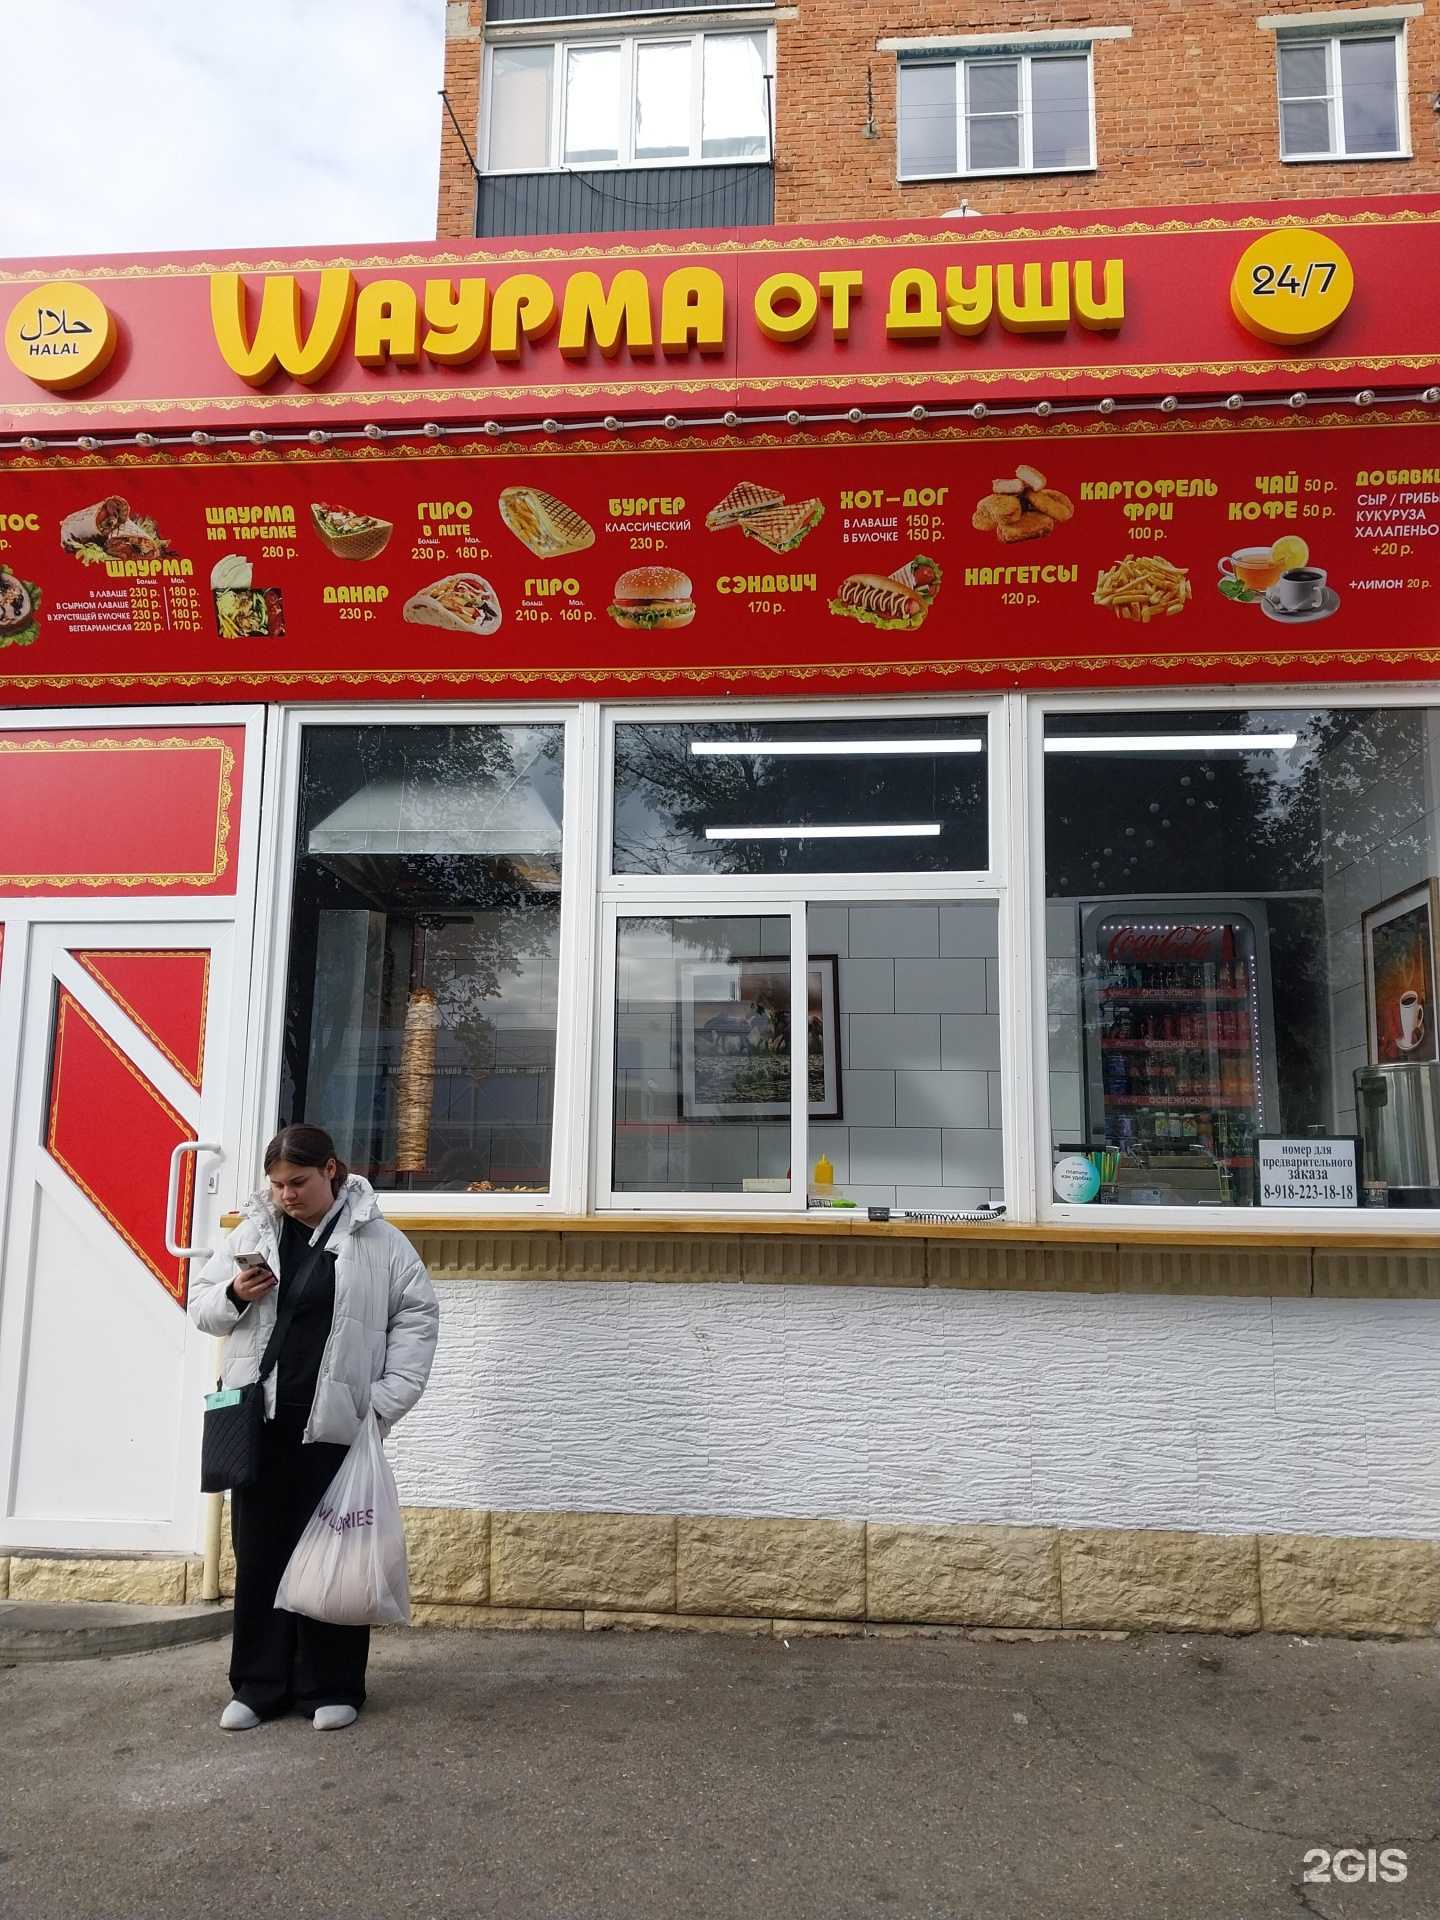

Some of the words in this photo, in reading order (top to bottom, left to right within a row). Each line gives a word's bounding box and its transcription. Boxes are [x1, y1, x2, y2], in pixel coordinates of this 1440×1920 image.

[1252, 263, 1337, 297] 24/7
[754, 270, 863, 342] ОТ
[885, 259, 1125, 338] ДУШИ
[20, 307, 93, 341] حلال
[29, 342, 80, 356] HALAL
[1080, 478, 1219, 501] КАРТОФЕЛЬ
[1255, 471, 1300, 495] ЧАЙ
[1303, 478, 1321, 492] 50
[607, 496, 687, 517] БУРГЕР
[1357, 493, 1388, 506] СЫР
[204, 504, 296, 525] ШАУРМА
[417, 500, 474, 520] ГИРО
[1123, 502, 1174, 521] ФРИ
[1228, 500, 1298, 521] КОФЕ
[1302, 504, 1320, 518] 50
[1356, 508, 1426, 522] КУКУРУЗА
[605, 518, 692, 533] КЛАССИЧЕСКИЙ
[843, 518, 850, 529] В
[852, 516, 898, 528] ЛАВАШЕ
[905, 514, 929, 527] 150
[206, 527, 227, 541] НА
[232, 525, 297, 540] ТАРЕЛКЕ
[422, 525, 432, 537] В
[438, 524, 471, 537] ПИТЕ
[843, 532, 850, 543] В
[851, 530, 899, 543] БУЛОЧКЕ
[906, 529, 930, 541] 150
[1128, 527, 1151, 540] 100
[630, 537, 652, 550] 230
[262, 545, 284, 558] 280
[411, 547, 433, 560] 230
[455, 546, 477, 559] 180
[105, 558, 194, 577] ШАУРМА
[964, 563, 1079, 586] НАГГЕТСЫ
[524, 577, 580, 596] ГИРО
[715, 573, 818, 595] СЭНДВИЧ
[1407, 578, 1420, 589] 20
[95, 589, 128, 598] ЛАВАШЕ
[129, 587, 148, 598] 230
[168, 586, 187, 596] 180
[322, 584, 390, 604] ДАНАР
[1001, 592, 1024, 605] 120
[62, 601, 96, 610] СЫРНОМ
[97, 601, 129, 609] ЛАВАШЕ
[130, 599, 149, 609] 240
[170, 598, 188, 608] 190
[748, 601, 770, 613] 170
[98, 612, 131, 621] БУЛОЧКЕ
[132, 610, 150, 620] 230
[171, 609, 189, 619] 180
[339, 607, 361, 620] 230
[515, 609, 537, 621] 210
[559, 608, 581, 621] 160
[133, 621, 152, 632] 220
[172, 620, 190, 630] 170
[1282, 1146, 1312, 1157] номер
[1314, 1146, 1332, 1156] для
[1262, 1158, 1353, 1171] предварительного
[1288, 1168, 1328, 1180] заказа
[1264, 1184, 1353, 1200] 8-918-223-18-18
